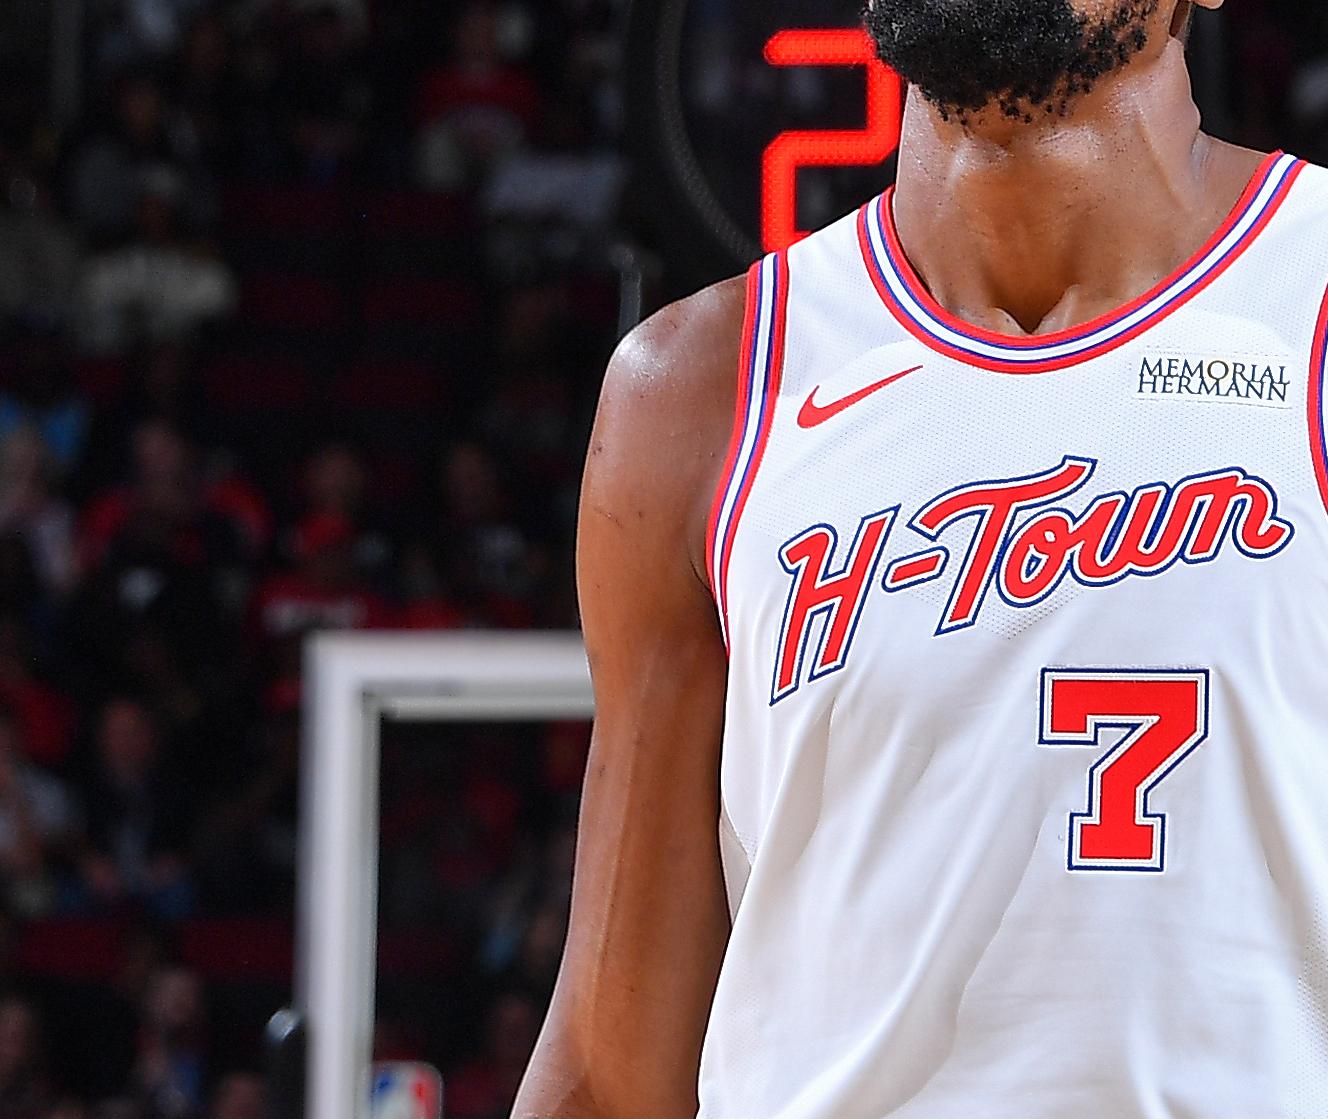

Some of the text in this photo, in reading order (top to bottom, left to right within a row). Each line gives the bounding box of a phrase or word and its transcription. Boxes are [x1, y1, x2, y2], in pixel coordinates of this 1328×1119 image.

[1137, 374, 1288, 402] HERMANN
[1138, 357, 1291, 385] MEMORIAL
[769, 454, 1296, 707] H-Town
[1037, 666, 1210, 873] 7
